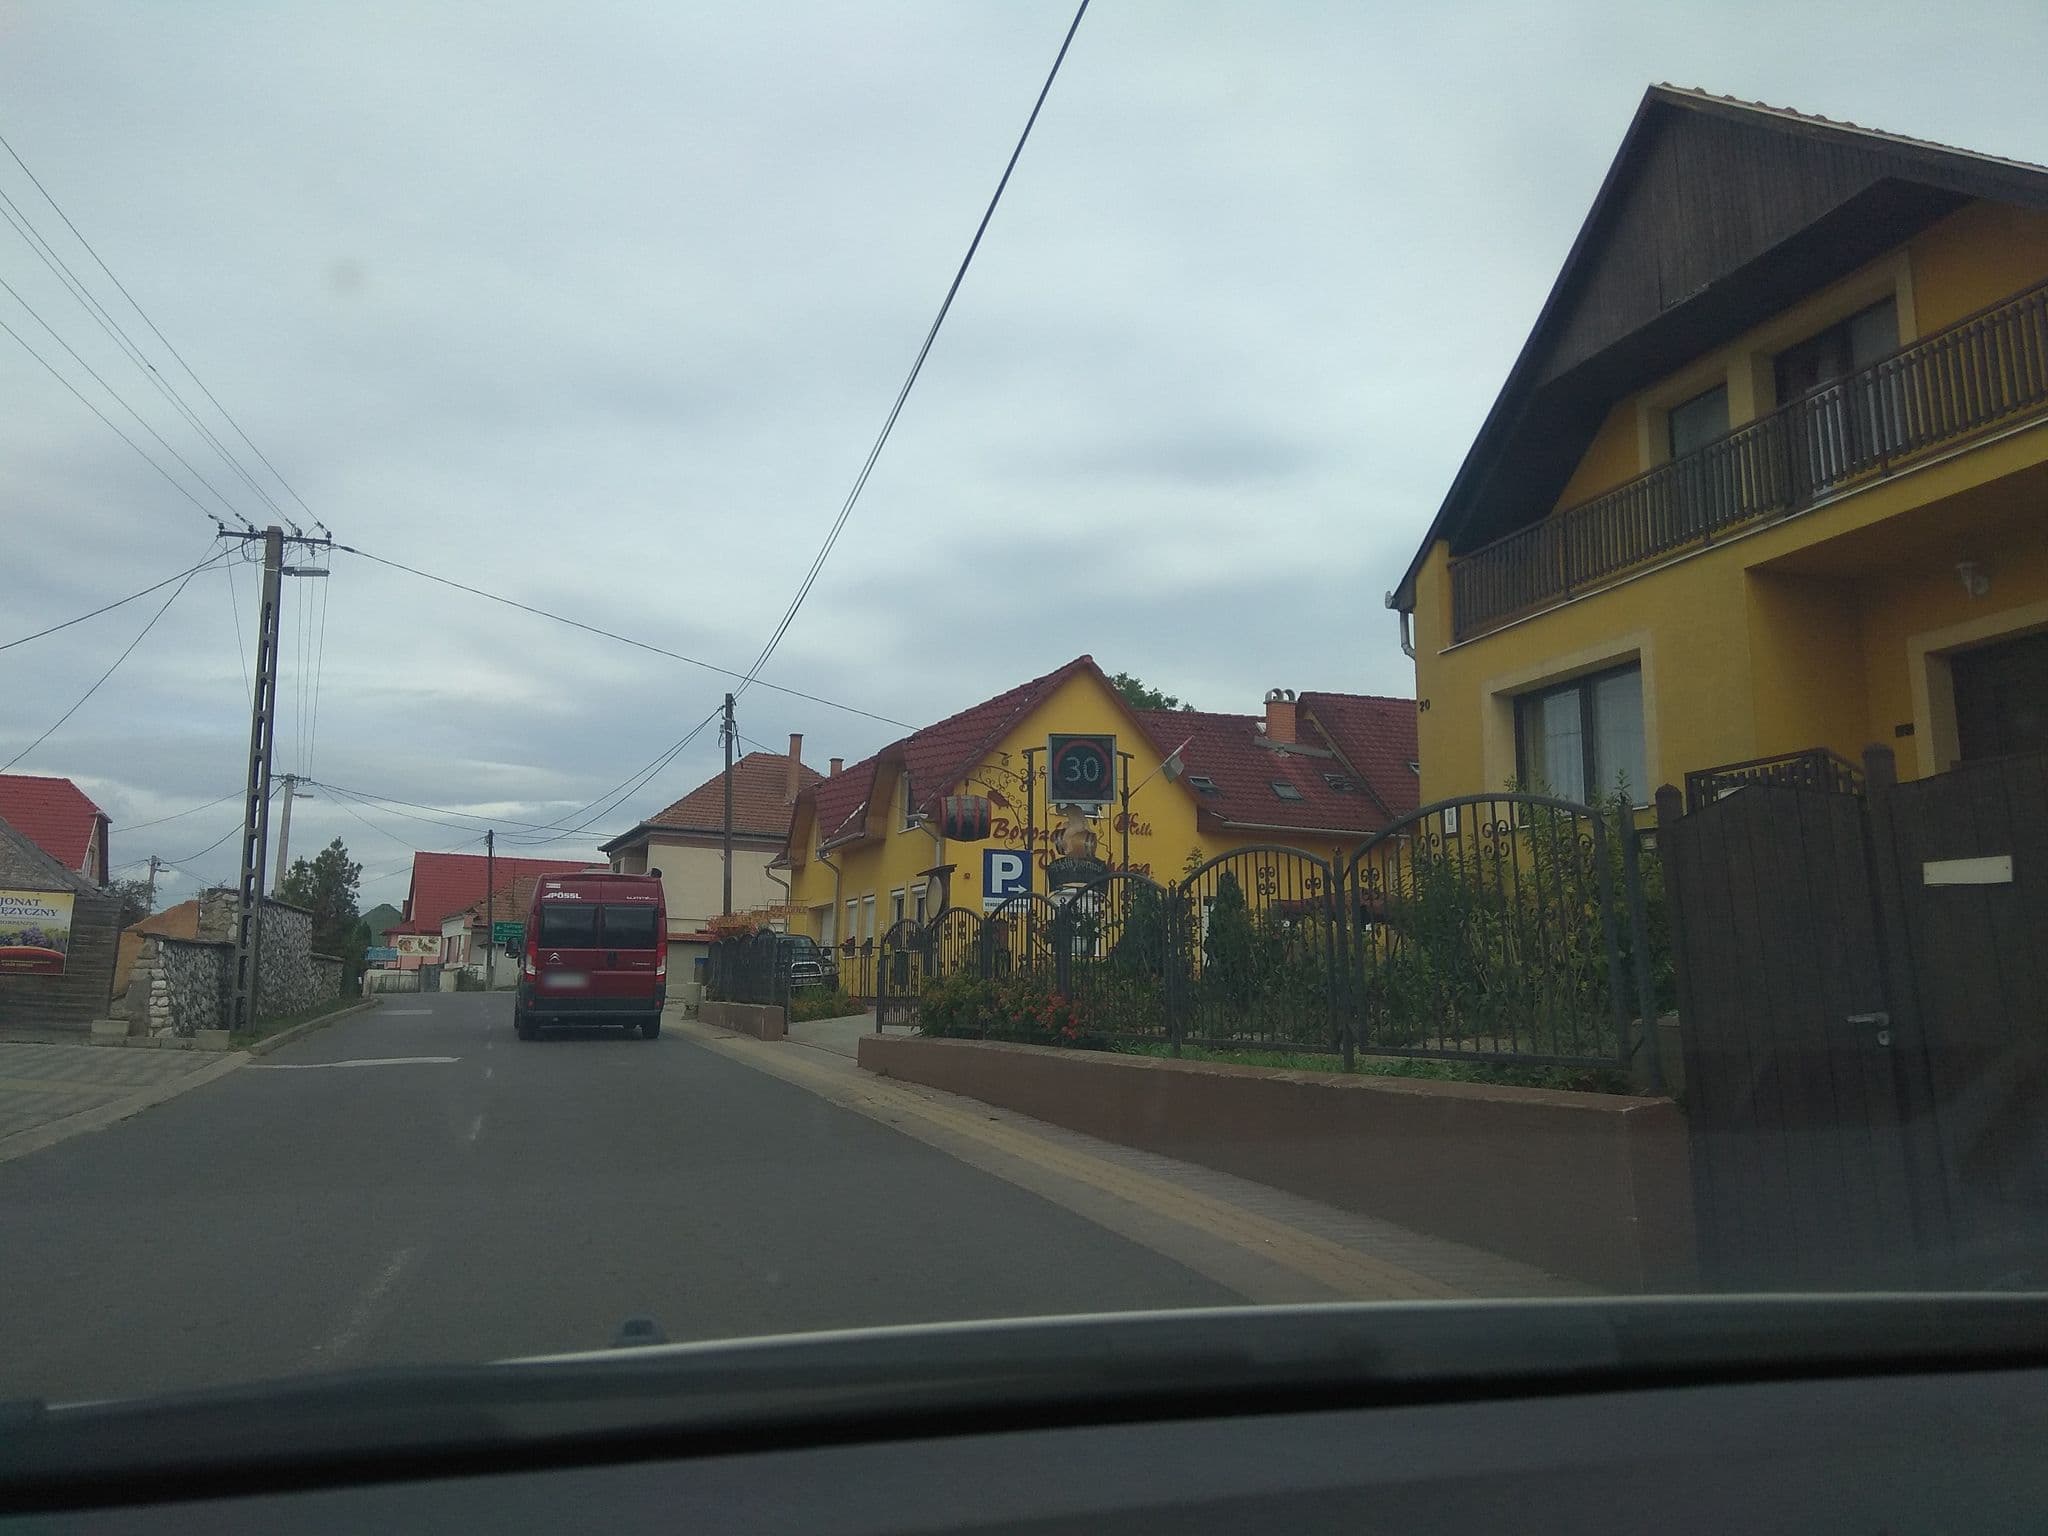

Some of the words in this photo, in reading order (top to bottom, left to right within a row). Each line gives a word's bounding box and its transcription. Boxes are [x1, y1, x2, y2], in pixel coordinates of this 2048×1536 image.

[1419, 698, 1431, 713] 20
[1065, 756, 1101, 783] 30
[991, 853, 1023, 894] P
[547, 891, 582, 899] PÖSSL
